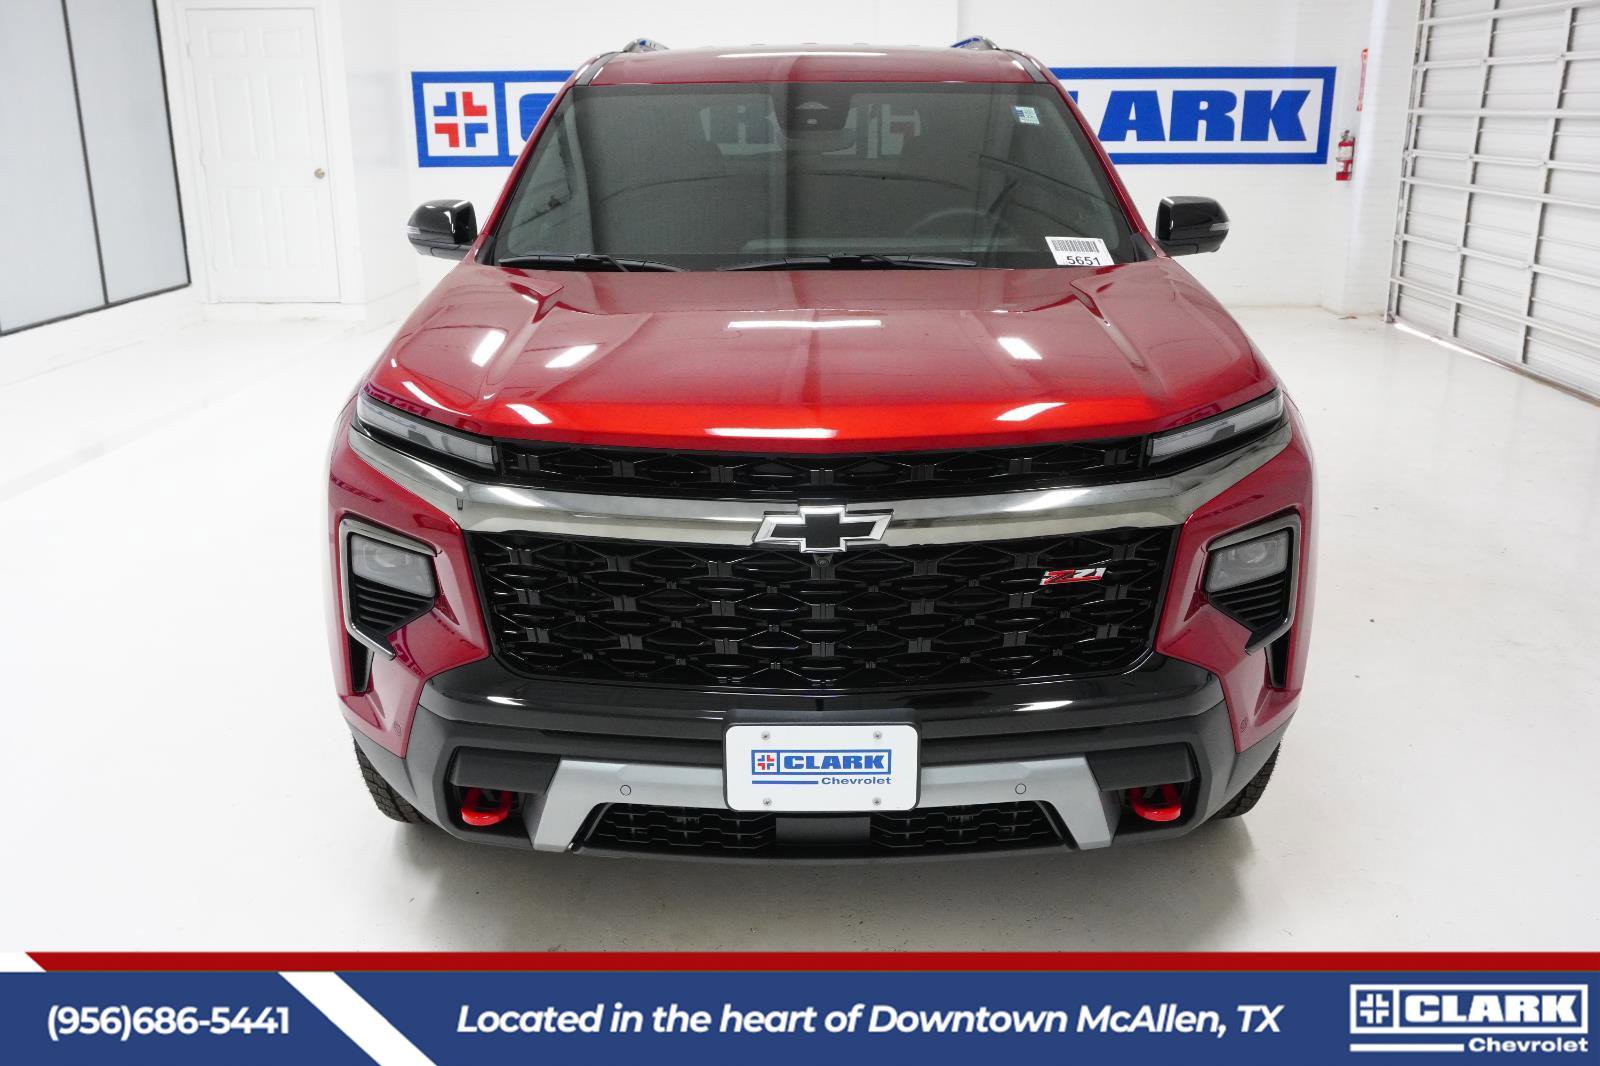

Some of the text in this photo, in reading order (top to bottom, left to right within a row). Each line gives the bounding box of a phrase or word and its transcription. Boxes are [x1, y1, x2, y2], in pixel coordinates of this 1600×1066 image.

[1067, 90, 1311, 142] ARK
[1066, 255, 1101, 266] 5651
[1040, 567, 1106, 586] Z71
[783, 755, 885, 770] CLARK
[821, 776, 892, 785] Chevrolet
